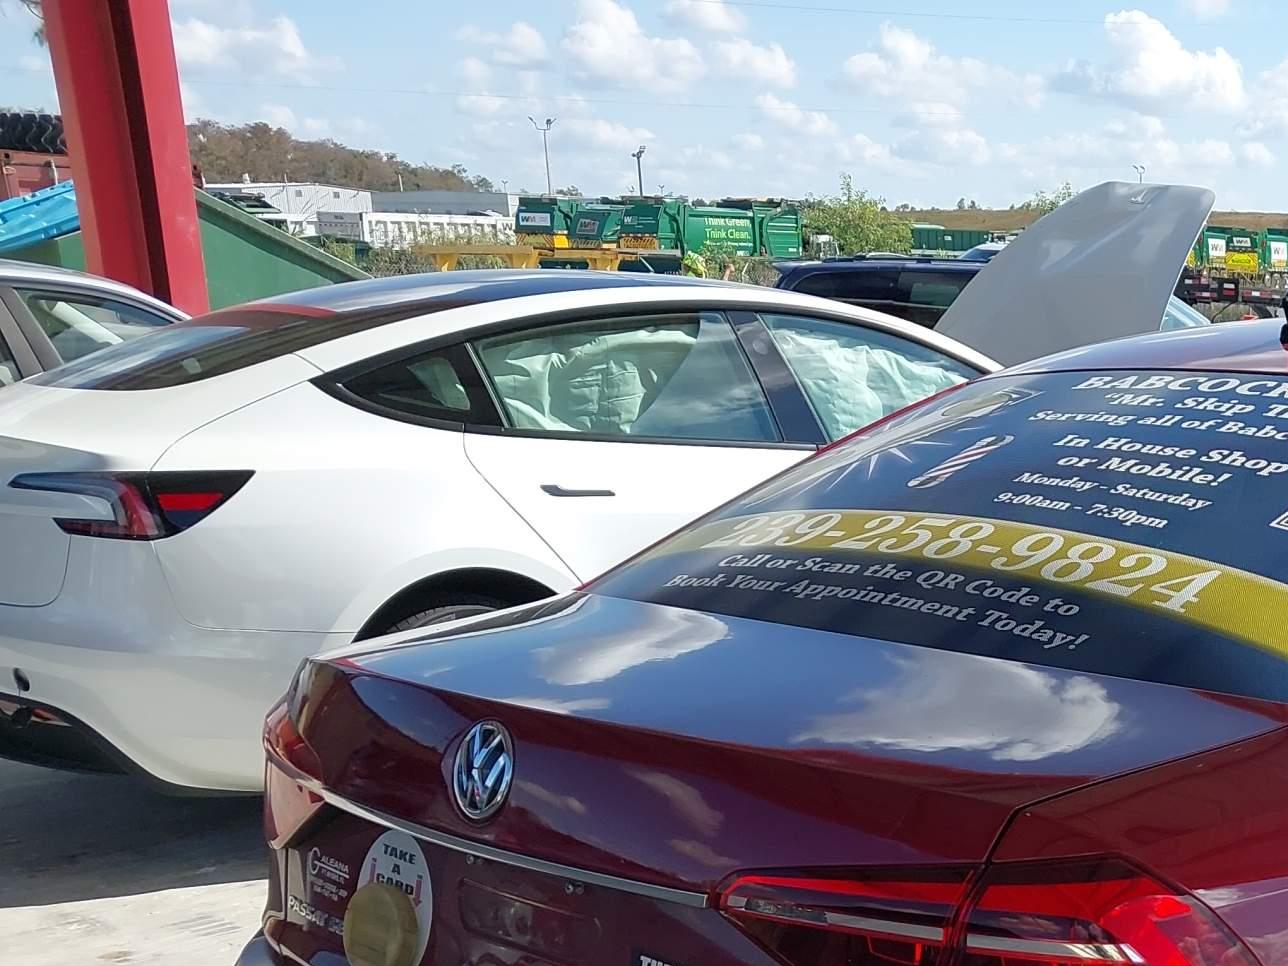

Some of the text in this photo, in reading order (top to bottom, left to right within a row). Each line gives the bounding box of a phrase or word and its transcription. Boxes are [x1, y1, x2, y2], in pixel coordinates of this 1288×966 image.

[1028, 410, 1137, 426] Serving
[1137, 415, 1182, 427] all
[1181, 418, 1222, 430] of
[1175, 397, 1255, 416] Skip
[1053, 434, 1090, 448] In
[1093, 437, 1197, 458] House
[1057, 456, 1232, 486] or Mobile!
[1013, 472, 1100, 492] Monday
[1109, 483, 1213, 511] Saturday
[994, 492, 1071, 511] 9:00am
[1085, 503, 1168, 529] 7:30pm
[700, 513, 1222, 613] 239-258-9824
[718, 554, 1081, 617] Call or Scan the QR Code to
[664, 574, 1091, 650] Book Your Appointment Today!
[383, 843, 416, 865] TAKE
[391, 863, 401, 875] A
